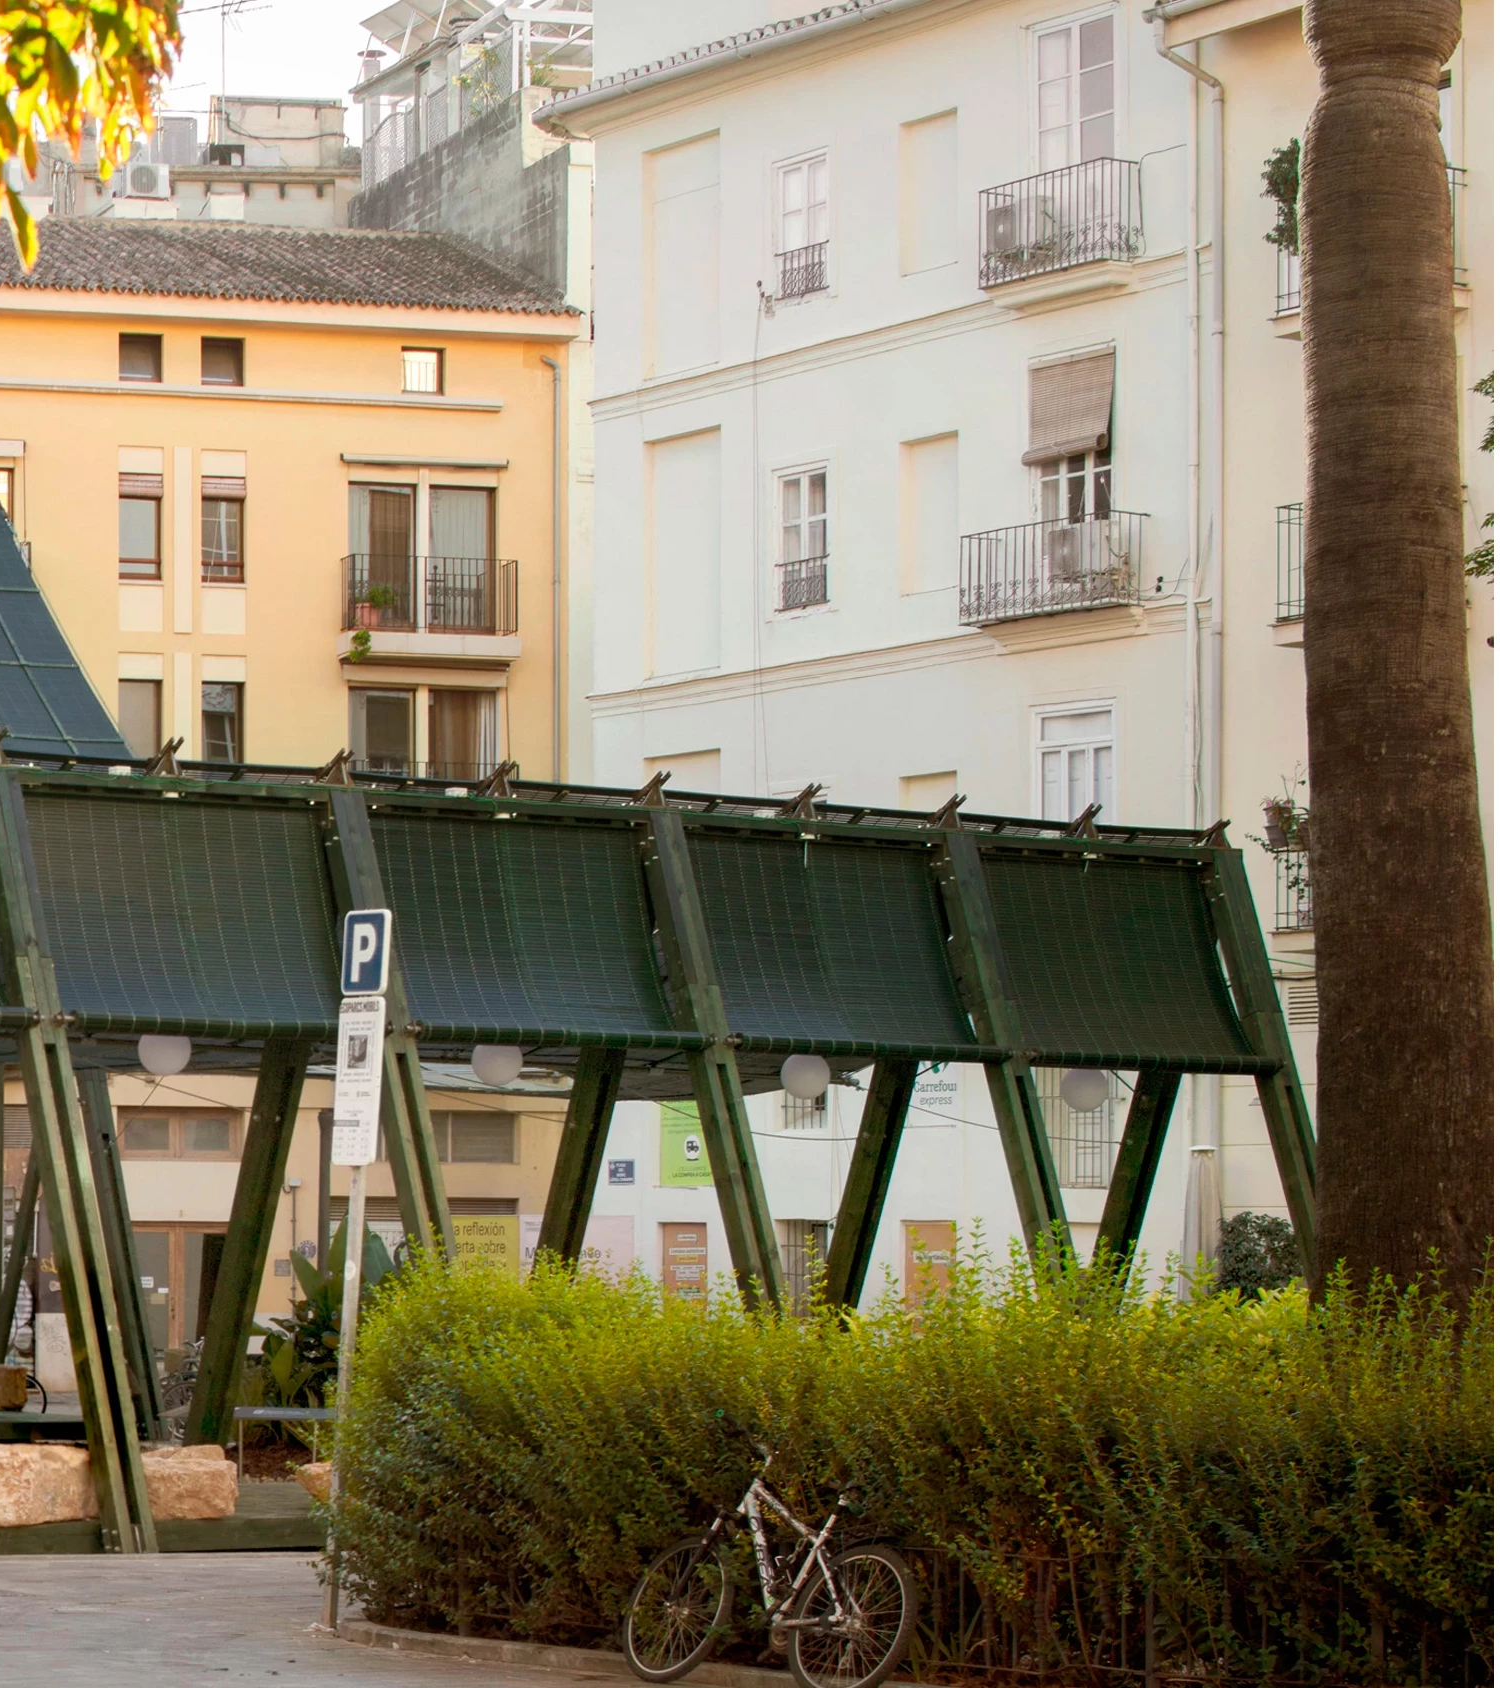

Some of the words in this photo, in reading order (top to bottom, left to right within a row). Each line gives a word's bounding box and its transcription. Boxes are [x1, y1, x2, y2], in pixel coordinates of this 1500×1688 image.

[350, 923, 376, 983] P
[920, 1096, 952, 1107] express
[463, 1222, 505, 1236] reflexión
